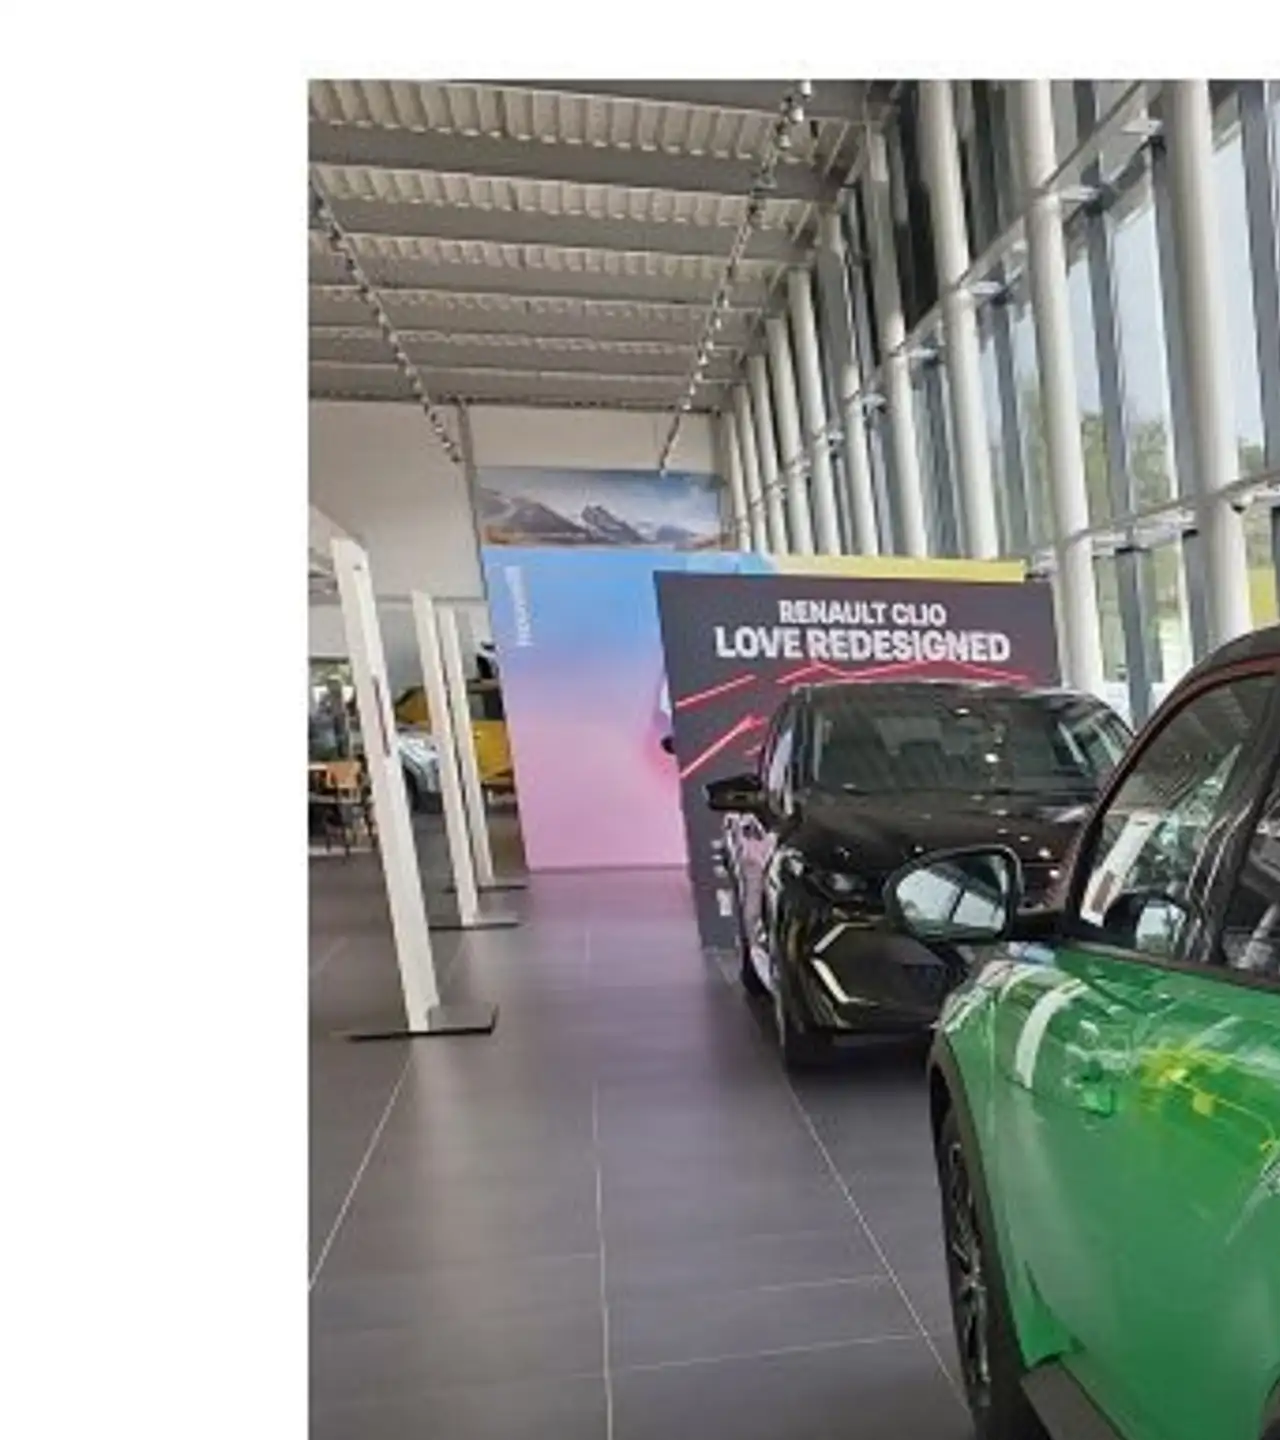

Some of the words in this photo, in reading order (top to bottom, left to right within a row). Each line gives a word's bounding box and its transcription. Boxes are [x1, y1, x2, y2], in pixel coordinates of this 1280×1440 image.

[778, 600, 887, 625] RENAULT
[892, 603, 946, 626] CLIO
[714, 626, 804, 659] LOVE
[807, 629, 1010, 662] REDESIGNED
